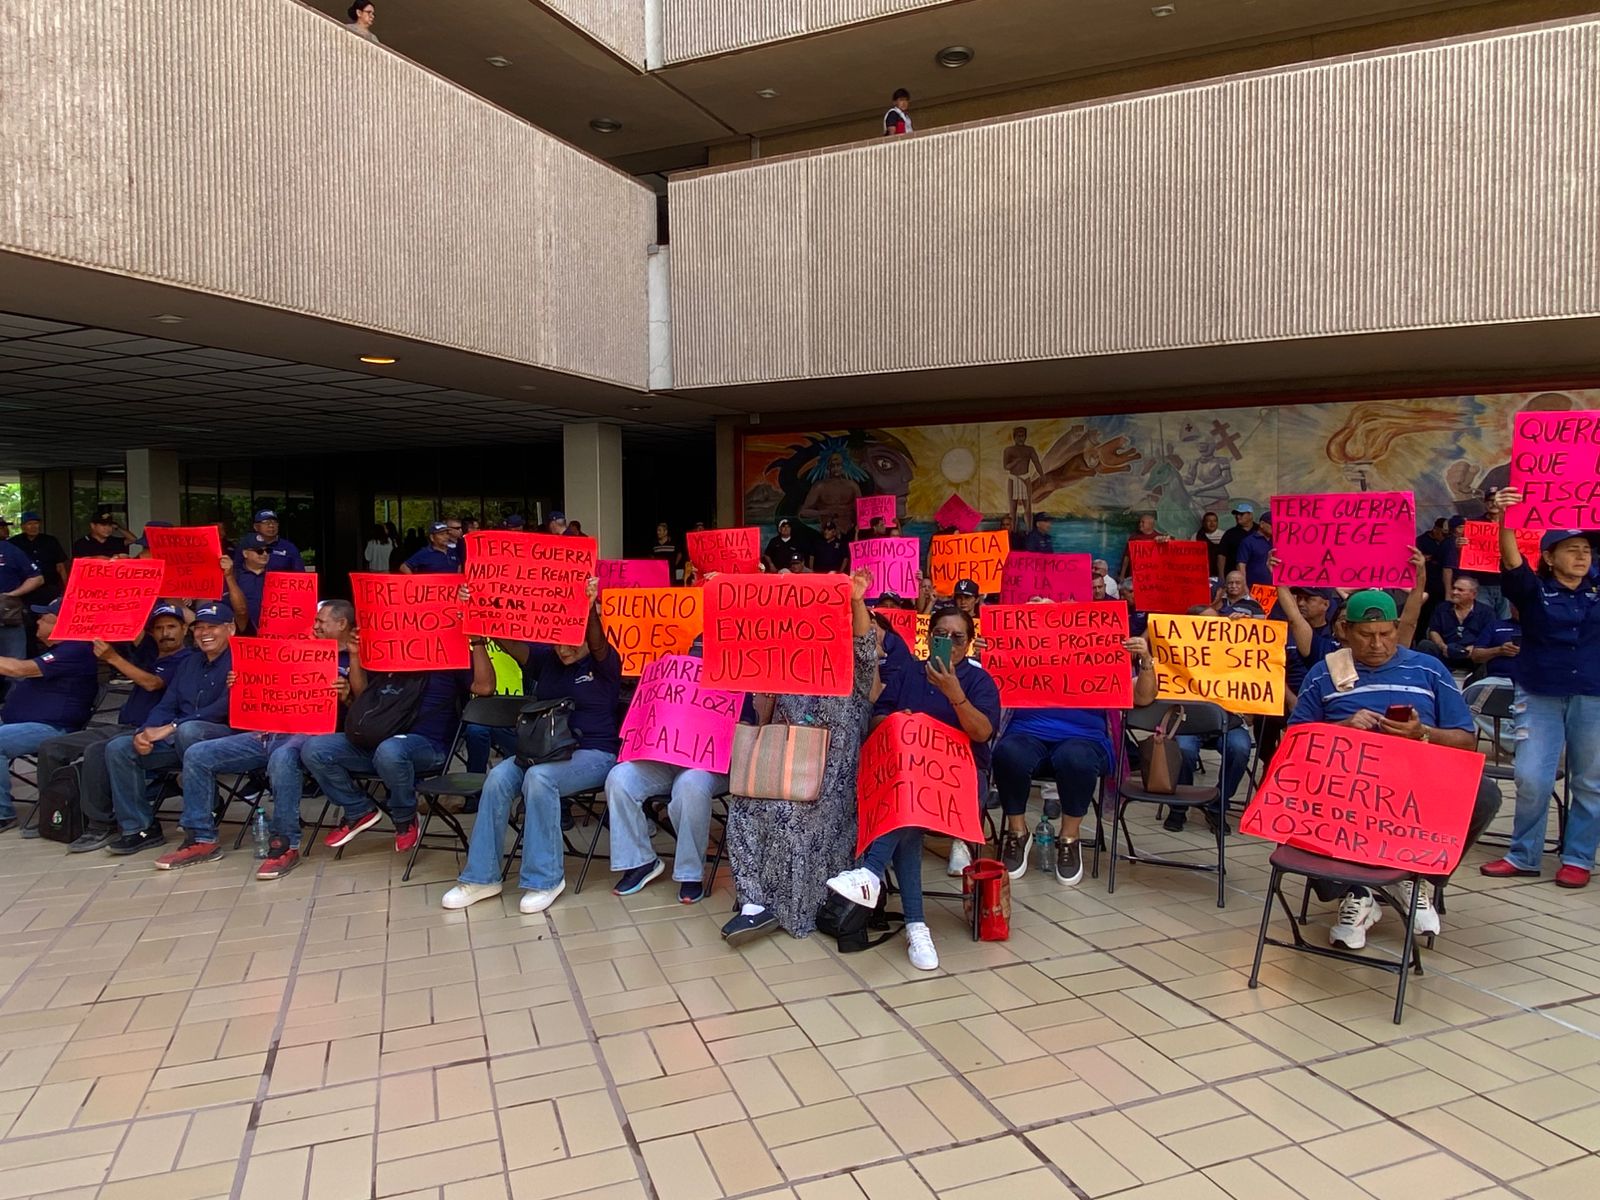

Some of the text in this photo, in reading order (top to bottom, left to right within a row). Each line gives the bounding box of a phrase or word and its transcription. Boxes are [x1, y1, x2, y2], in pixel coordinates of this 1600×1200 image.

[1515, 452, 1568, 475] QUE
[1273, 498, 1412, 521] TERE GUERRA
[693, 531, 750, 551] YESENIA
[932, 534, 1001, 555] JUSTICIA
[1275, 521, 1388, 545] PROTEGE
[473, 535, 592, 567] TERE GUERRA
[698, 549, 752, 564] NO ESTA
[854, 541, 916, 559] EXIGIMOS
[1321, 548, 1336, 566] A
[115, 566, 162, 580] GUERRA
[468, 563, 510, 580] NADIE
[516, 565, 537, 580] LE
[864, 561, 917, 592] TICIA
[934, 559, 1004, 581] MUERTA
[1278, 563, 1414, 584] LOZA OCHOA
[115, 588, 141, 599] ESTA
[144, 588, 158, 597] EL
[358, 578, 400, 607] TERE
[468, 582, 575, 600] SU TRAYECTORIA
[1034, 575, 1052, 590] LA
[270, 592, 289, 604] DE
[467, 596, 567, 615] A OSCAR LOZA
[603, 593, 696, 619] SILENCIO
[719, 582, 848, 611] DIPUTADOS
[72, 615, 96, 624] QUE
[469, 610, 585, 627] PERO QUE NO QUEDE
[717, 615, 836, 642] EXIGIMOS
[989, 609, 1038, 631] TERE
[1044, 610, 1122, 629] GUERRA
[482, 621, 562, 642] IMPUNE
[606, 624, 679, 649] NO ES
[985, 632, 1126, 652] DEJA DE PROTEGER
[1153, 620, 1276, 645] LA VERDAD
[238, 641, 336, 662] TERE GUERRA
[361, 637, 448, 664] USTICIA
[987, 650, 1126, 669] AL VIOLENTADOR
[1156, 644, 1271, 672] DEBE SER
[291, 671, 327, 685] ESTA
[710, 646, 836, 688] JUSTICIA
[243, 687, 337, 701] EL PRESUPUESTO
[992, 673, 1122, 696] OSCAR LOZA
[1157, 673, 1274, 703] ESCUCHADA
[632, 682, 736, 718] A OSCAR LOZA
[646, 703, 656, 727] A
[619, 725, 714, 768] FISCALIA
[901, 719, 973, 767] GUERRA
[1285, 731, 1383, 780] TERE
[862, 753, 962, 800] EXIGIMOS
[1274, 762, 1421, 825] GUERRA
[1264, 791, 1460, 849] DEJE DE PROTEGER
[1245, 809, 1449, 871] A OSCAR LOZA
